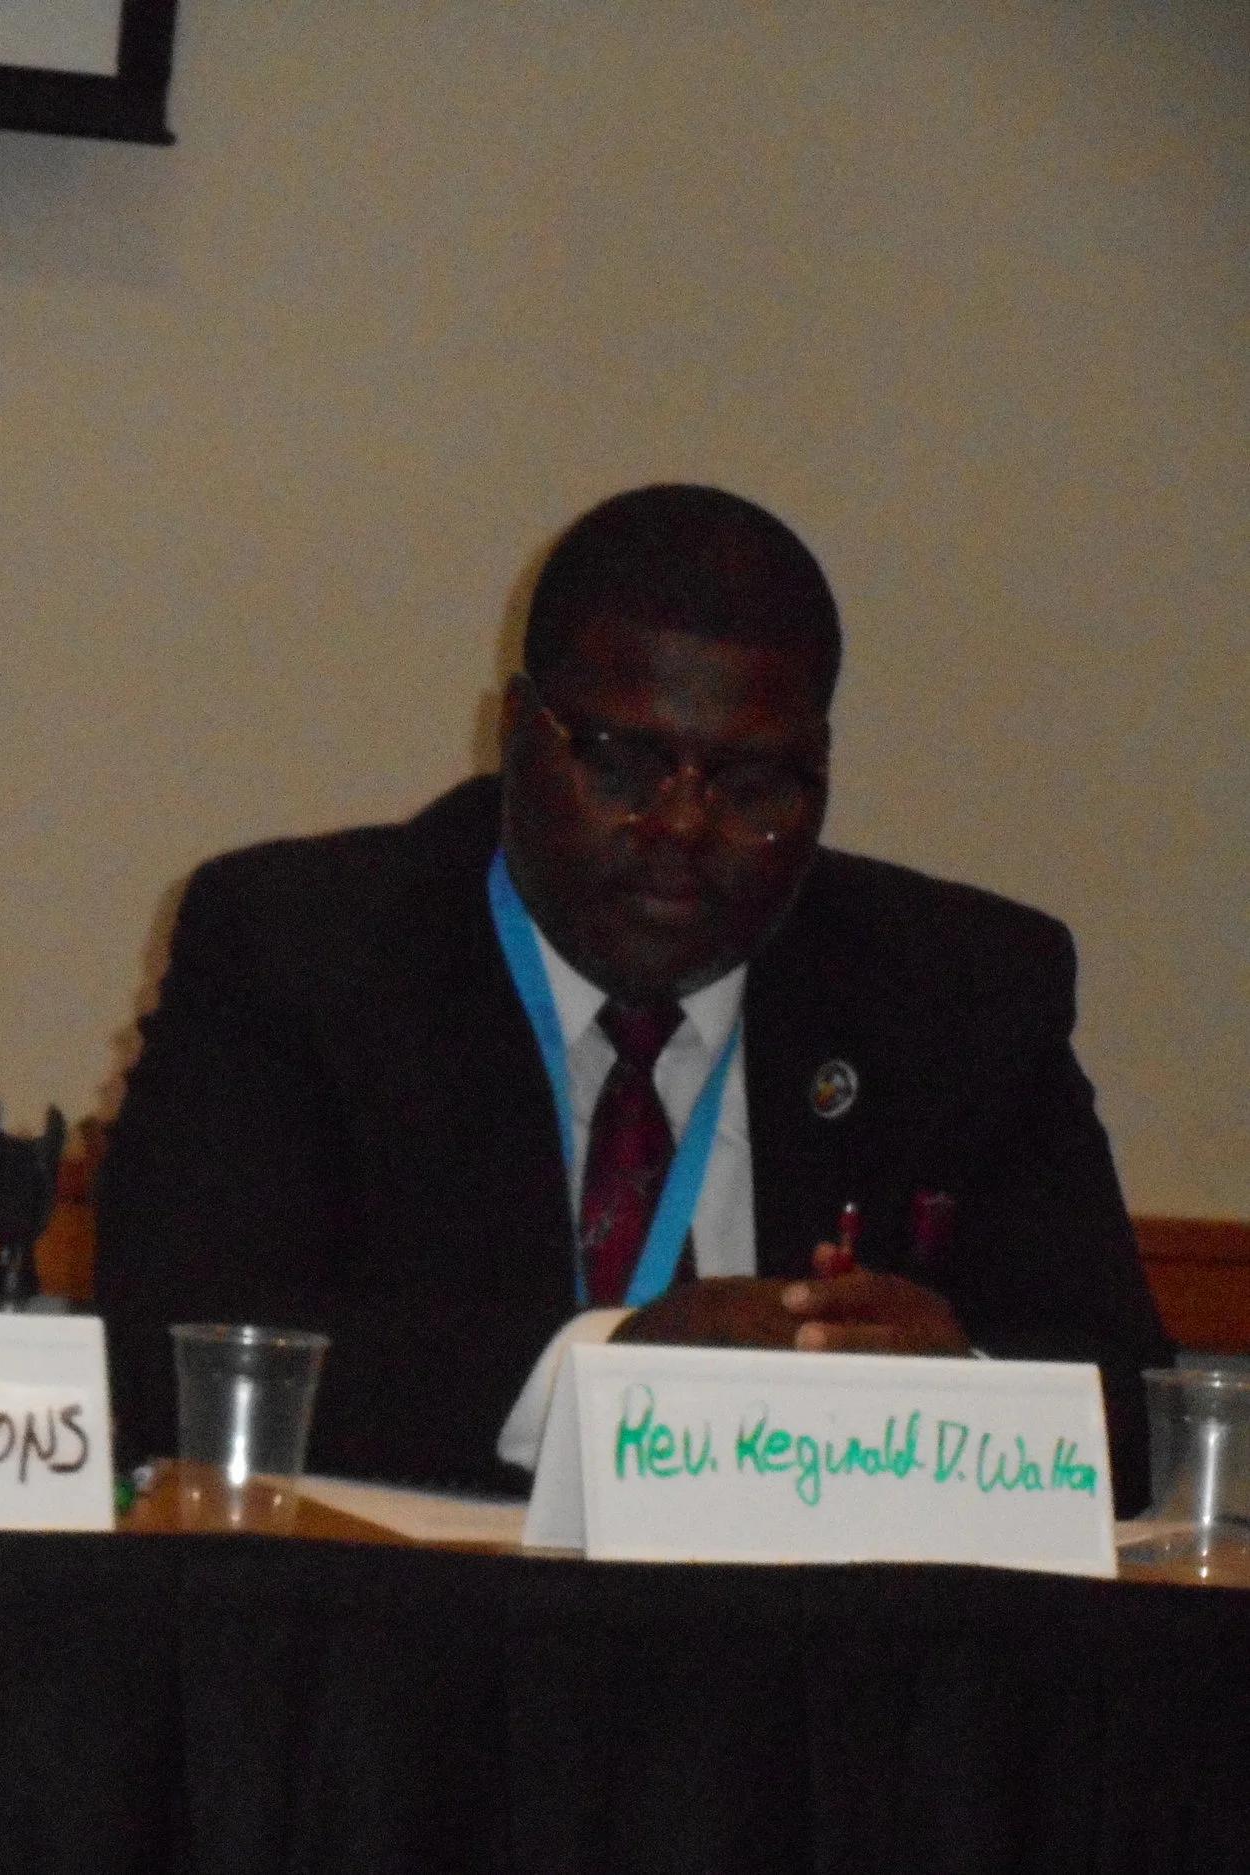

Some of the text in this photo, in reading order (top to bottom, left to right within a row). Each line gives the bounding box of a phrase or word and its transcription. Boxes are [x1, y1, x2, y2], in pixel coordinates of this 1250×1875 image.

[615, 1384, 718, 1480] Rev.
[735, 1403, 925, 1507] Reginald
[934, 1420, 967, 1483] D.
